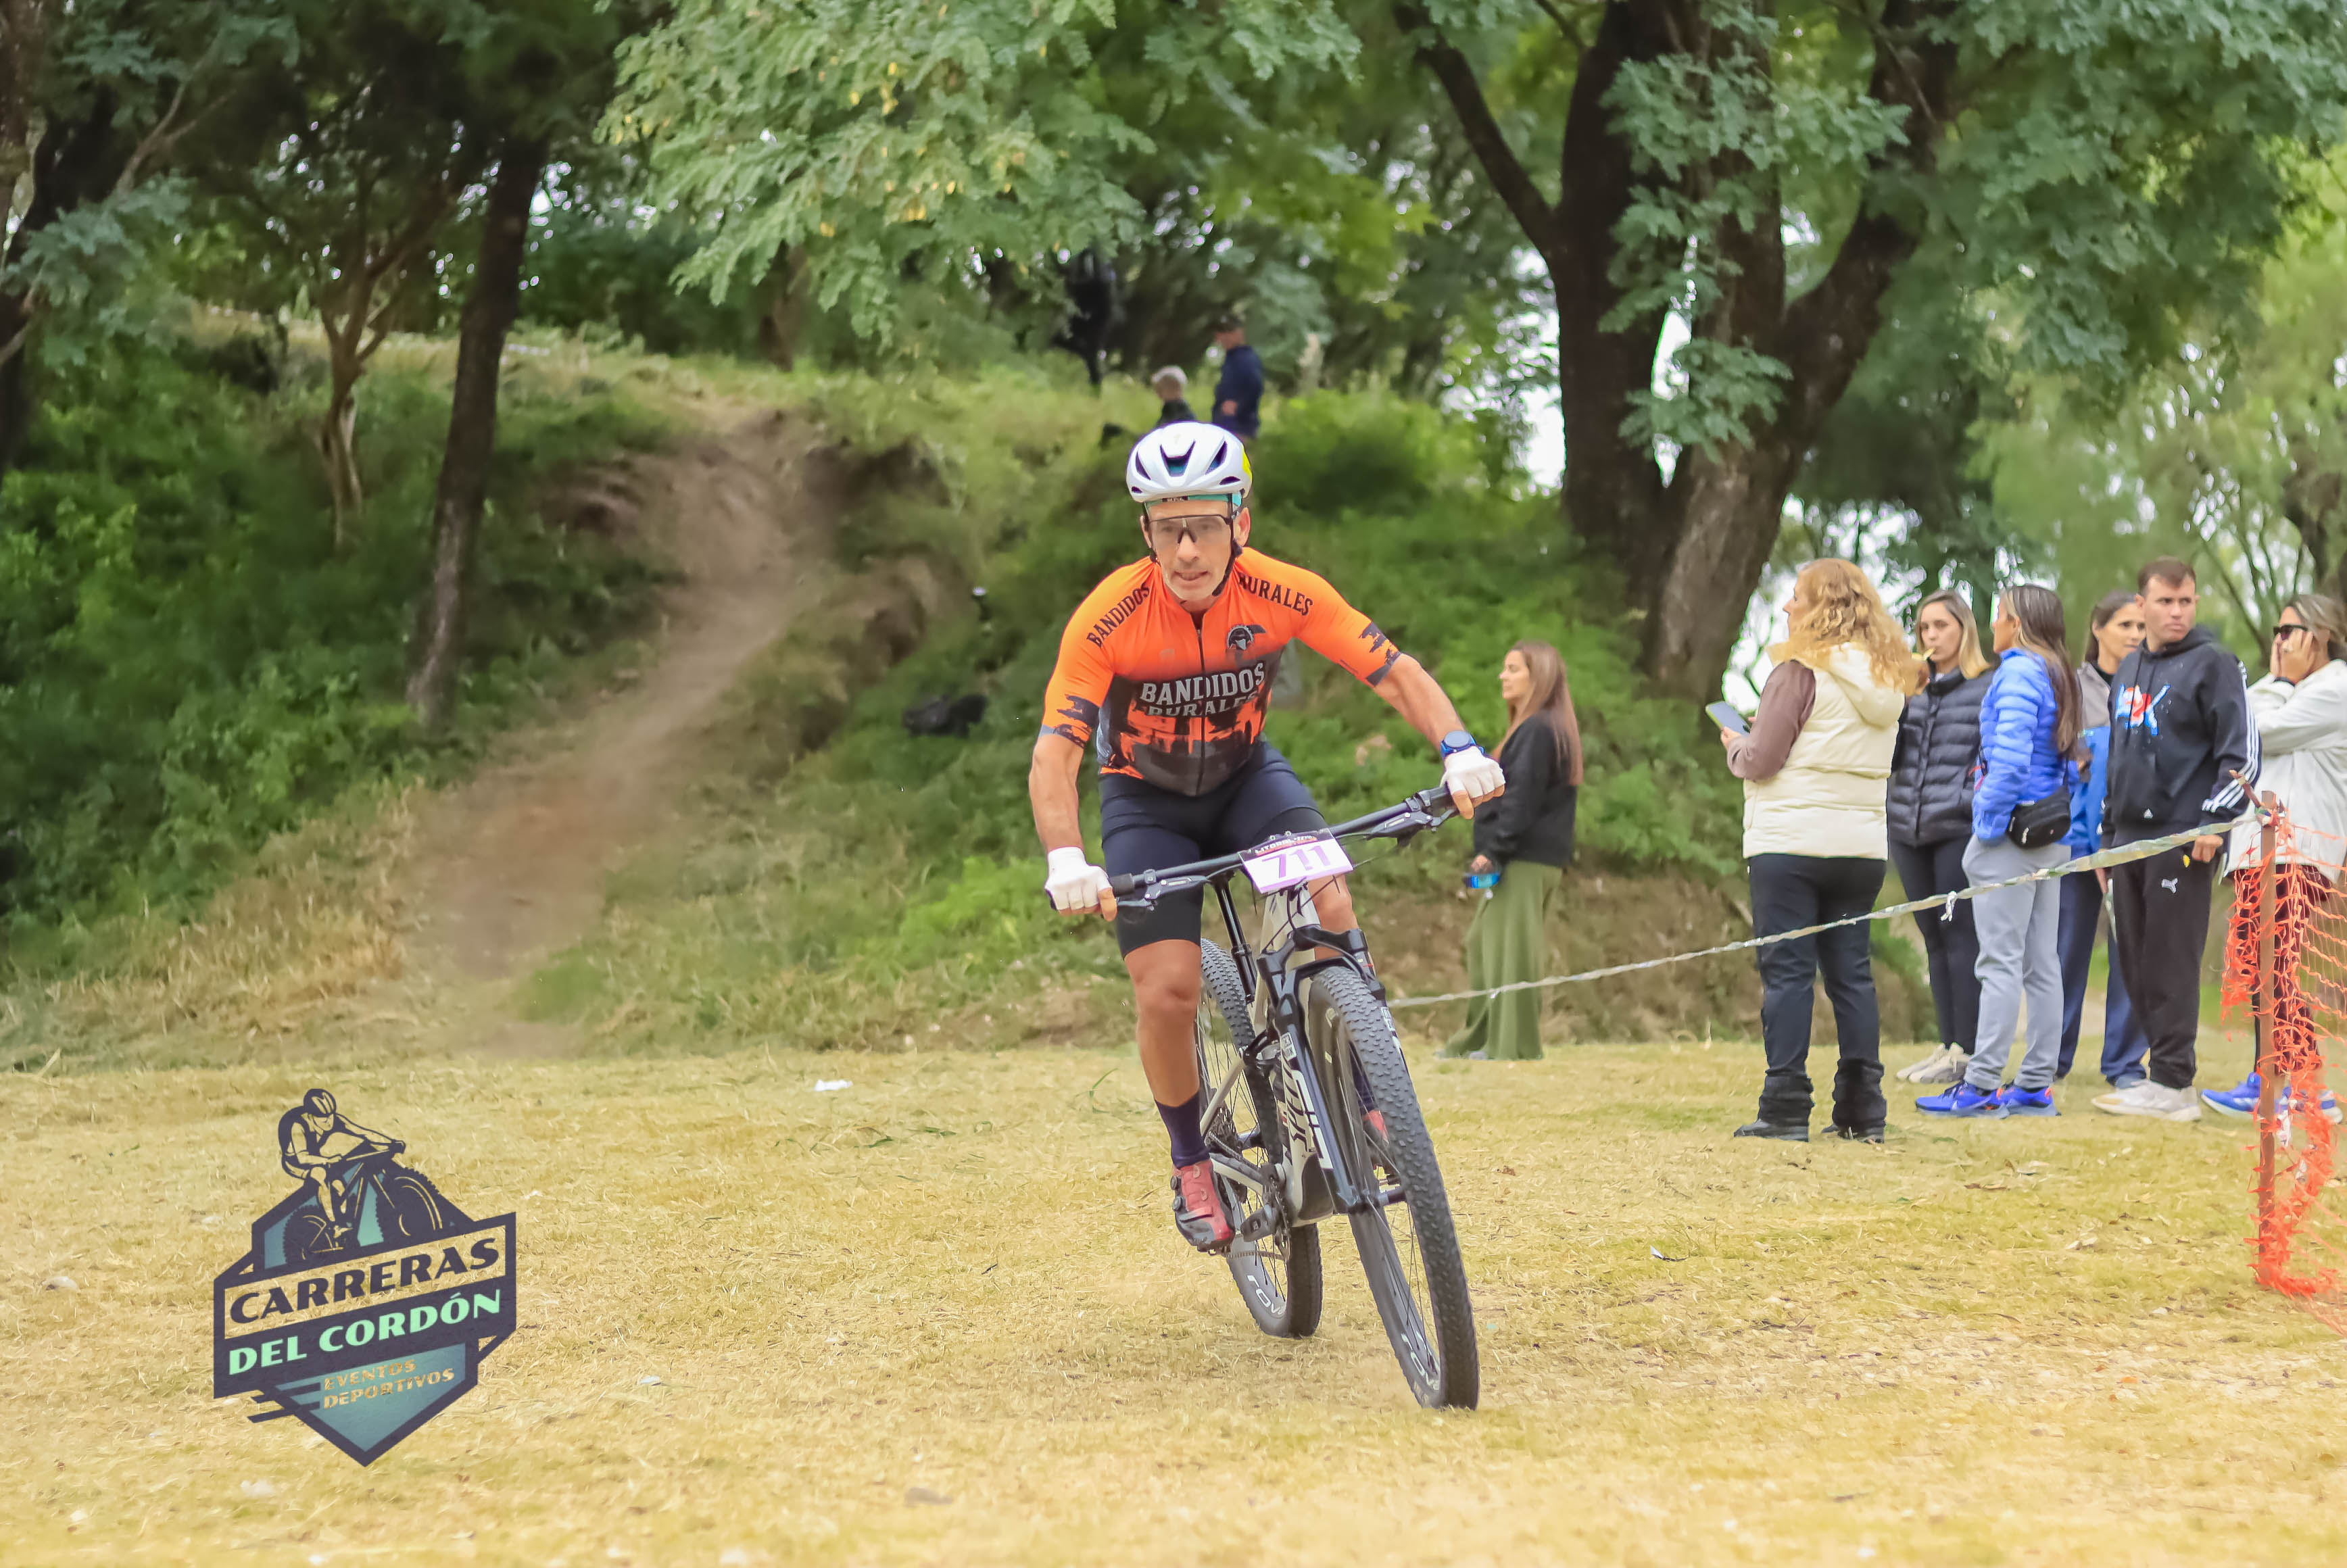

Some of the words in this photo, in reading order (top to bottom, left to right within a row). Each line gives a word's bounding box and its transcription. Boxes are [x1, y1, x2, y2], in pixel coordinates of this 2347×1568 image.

[1086, 581, 1149, 648] BANDIDOS
[1140, 662, 1265, 705] BANDIDOS
[1262, 846, 1331, 879] 711
